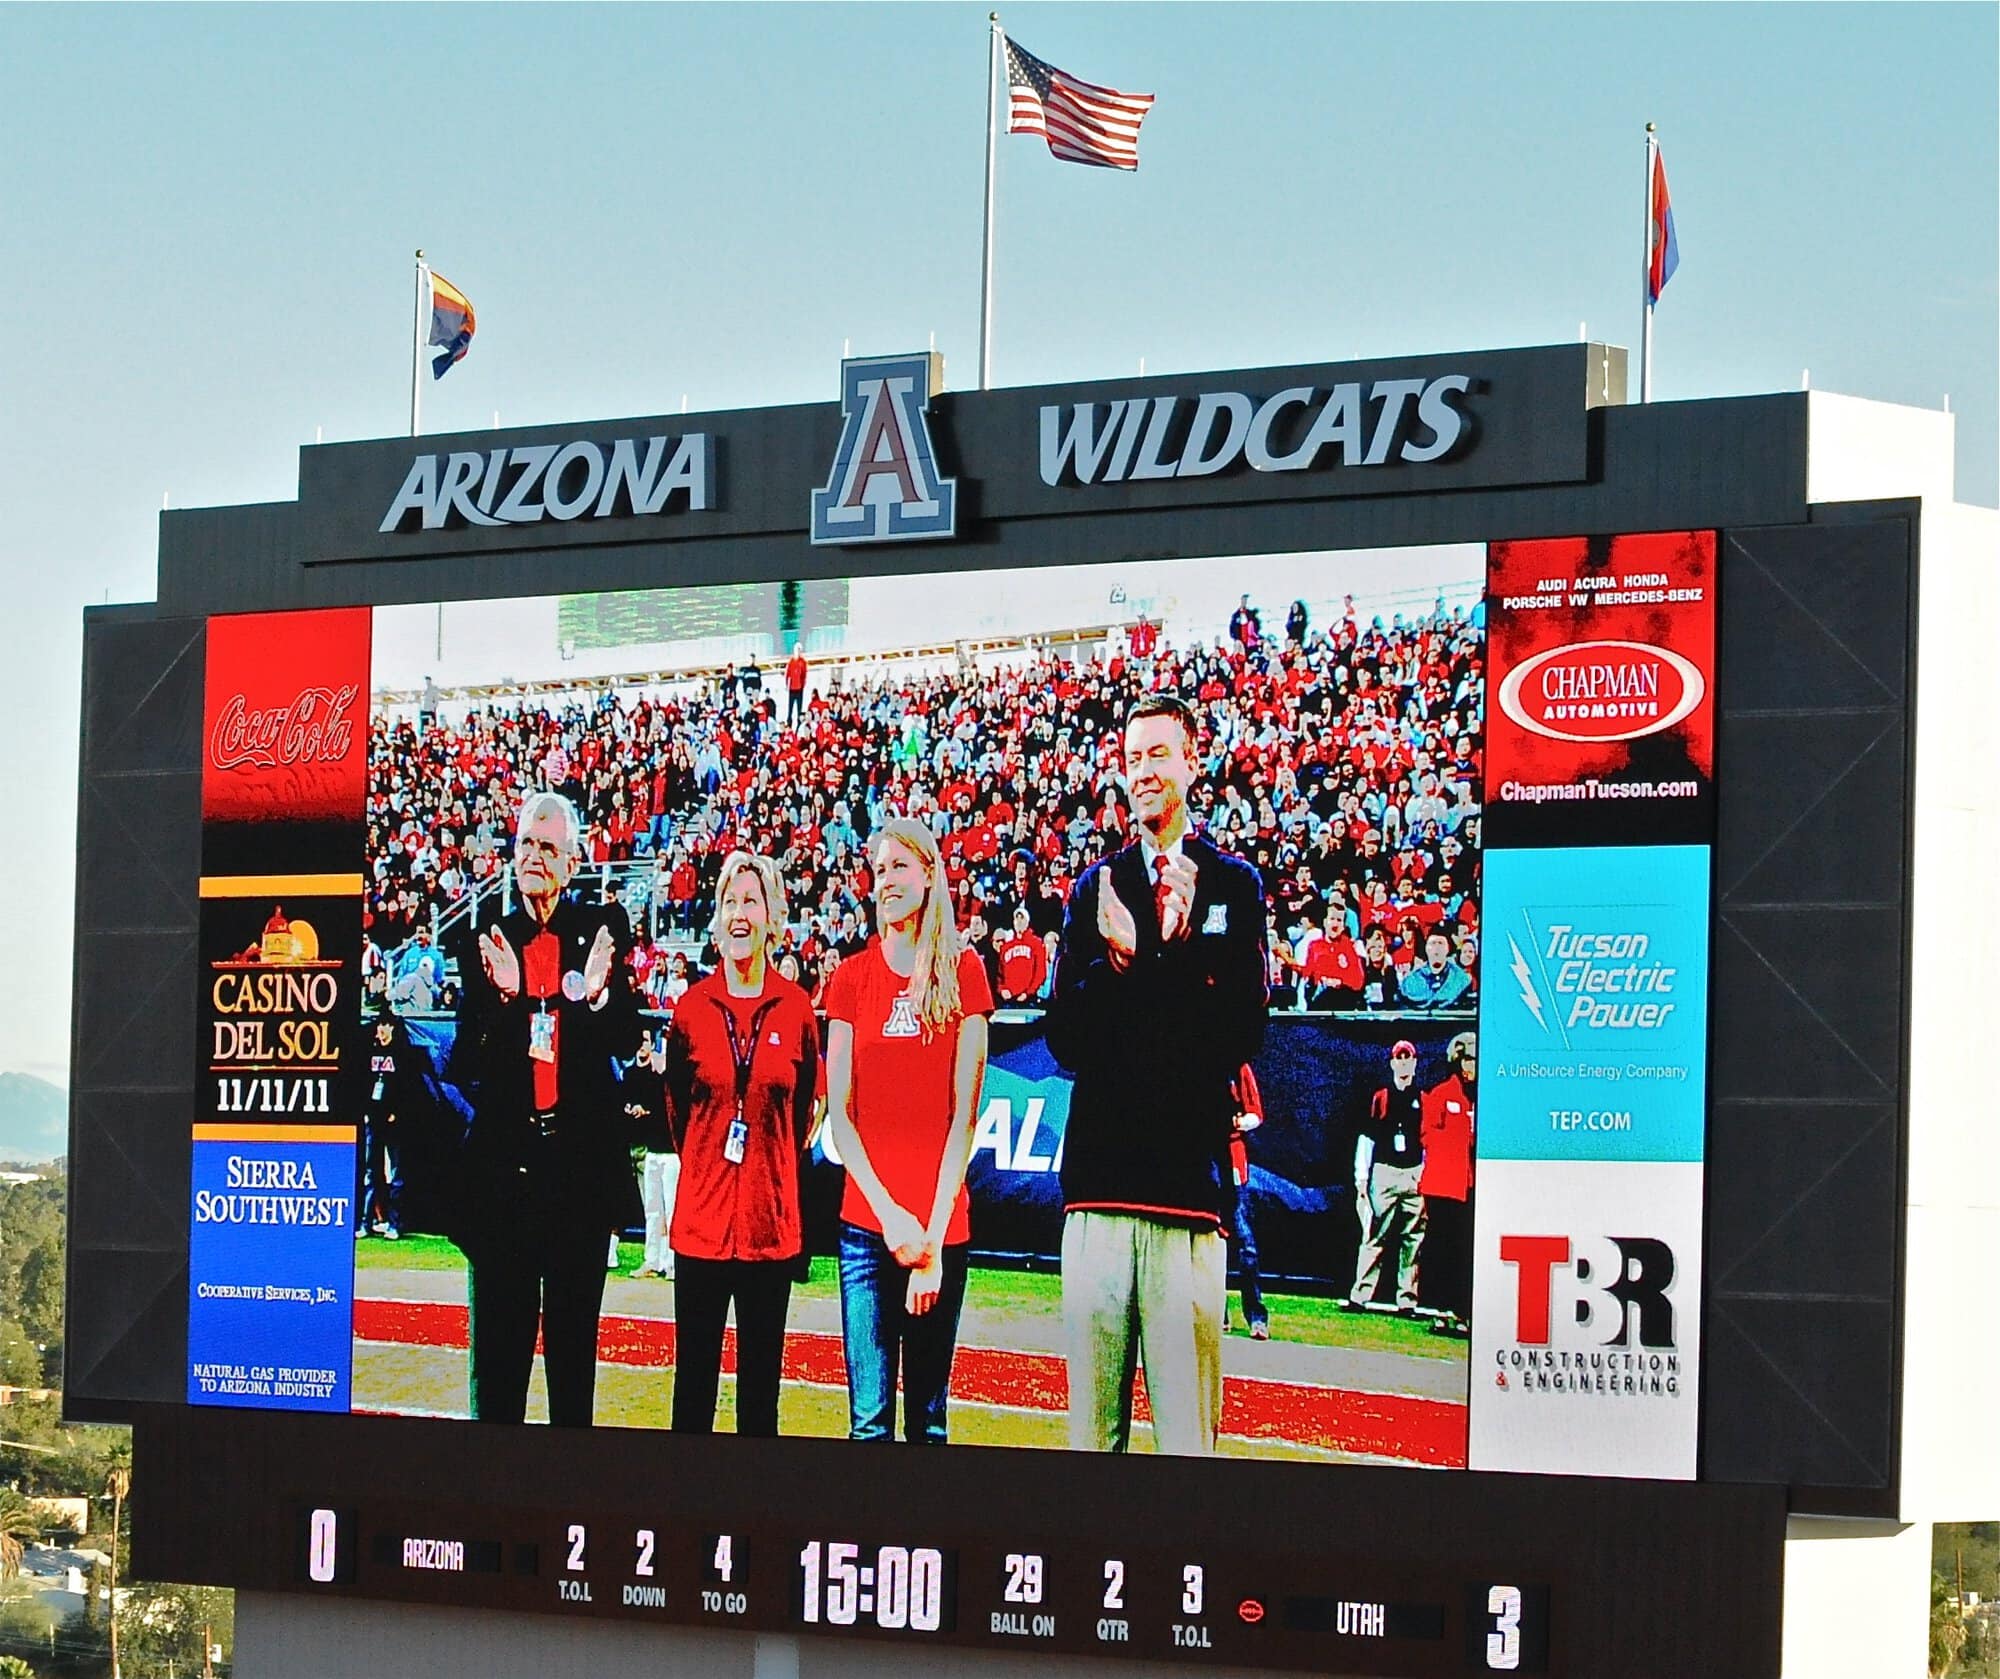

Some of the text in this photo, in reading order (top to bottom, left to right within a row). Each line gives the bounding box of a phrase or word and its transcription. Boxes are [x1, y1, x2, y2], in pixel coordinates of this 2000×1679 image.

[1039, 374, 1470, 486] WILDCATS
[379, 432, 707, 532] ARIZONA
[1503, 589, 1703, 609] PORSCHE VW MERCEDES-BENZ
[1537, 574, 1668, 591] AUDI ACURA HONDA
[1542, 664, 1659, 699] CHAPMAN
[1543, 702, 1658, 719] AUTOMOTIVE
[1500, 780, 1698, 803] ChapmanTucson.com
[1546, 925, 1648, 959] Tucson
[213, 973, 338, 1014] CASINO
[1555, 961, 1676, 993] Electric
[1566, 996, 1674, 1029] Power
[212, 1021, 340, 1060] DEL SOL
[1496, 1064, 1688, 1081] A UniSource Energy Company
[217, 1078, 330, 1113] 11/11/11
[1550, 1111, 1631, 1131] TEP.COM
[226, 1155, 318, 1190] SIERRA
[195, 1190, 349, 1227] SOUTHWEST
[1500, 1235, 1677, 1348] TBR
[193, 1363, 337, 1384] NATURAL GAS PROVIDER
[1496, 1350, 1678, 1372] CONSTRUCTION
[200, 1378, 334, 1399] TO ARIZONA INDUSTRY
[1496, 1371, 1678, 1394] & ENGINEERING
[403, 1538, 464, 1571] ARIZONA
[566, 1525, 586, 1571] 2
[635, 1530, 656, 1576] 2
[714, 1535, 733, 1582] 4
[558, 1580, 593, 1602] T.O.L
[622, 1584, 666, 1607] DOWN
[800, 1541, 943, 1632] 15:00
[1004, 1554, 1043, 1604] 29
[1104, 1560, 1125, 1609] 2
[1183, 1565, 1204, 1614] 3
[702, 1590, 747, 1614] TO GO
[990, 1612, 1055, 1638] BALL ON
[1096, 1619, 1129, 1641] QTR
[1336, 1601, 1385, 1637] UTAH
[1486, 1585, 1522, 1670] 3
[1173, 1625, 1212, 1648] T.O.L
